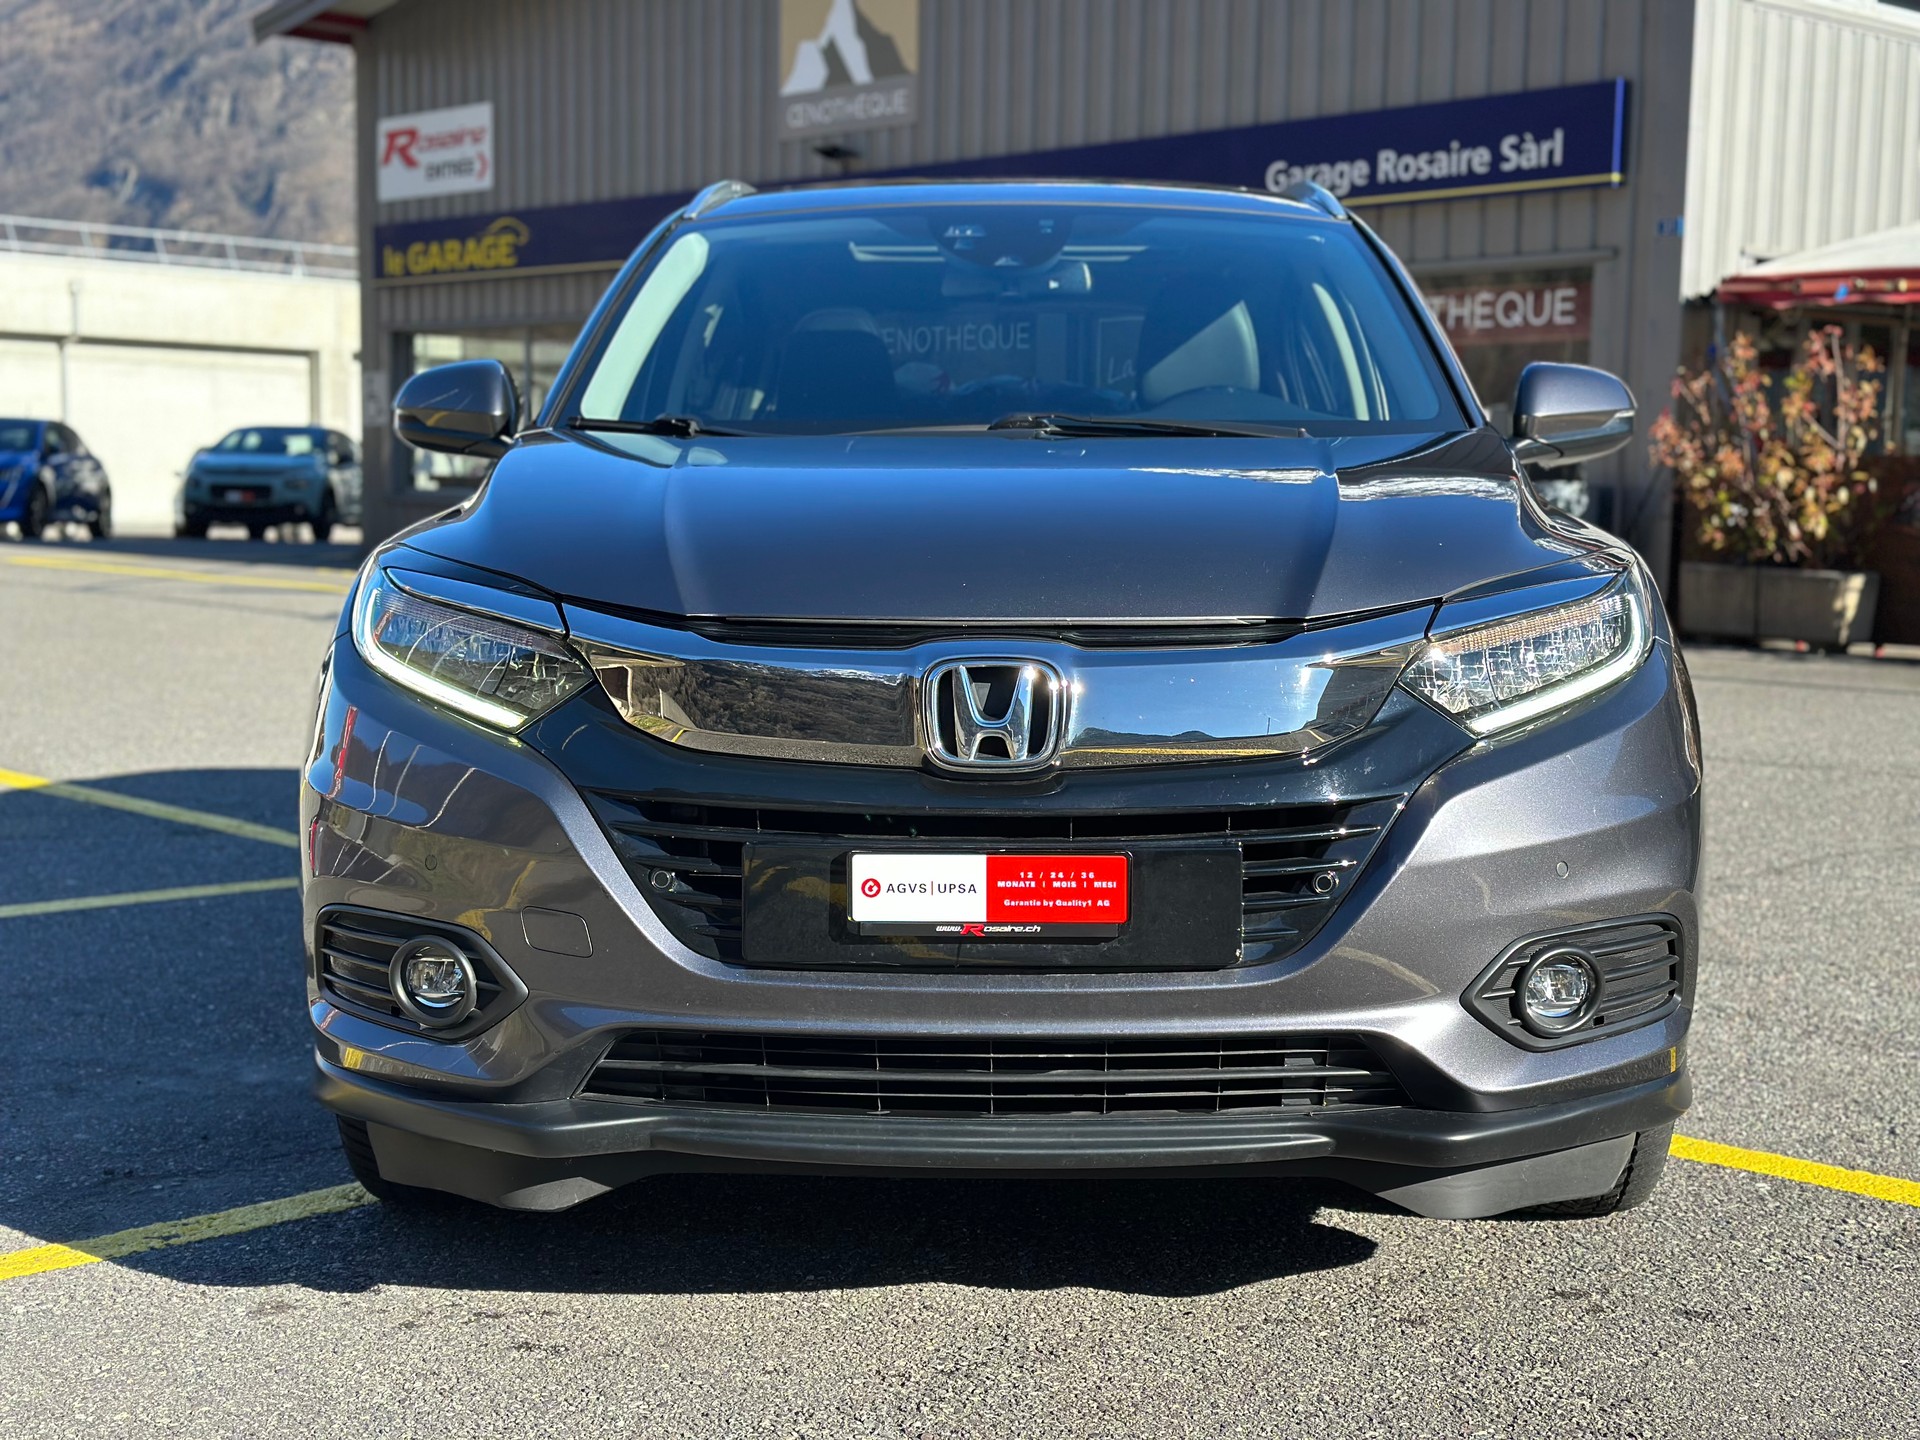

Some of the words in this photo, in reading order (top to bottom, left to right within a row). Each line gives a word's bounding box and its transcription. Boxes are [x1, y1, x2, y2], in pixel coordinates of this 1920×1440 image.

[1264, 159, 1371, 197] Garage
[1376, 140, 1491, 184] Rosaire
[1499, 127, 1565, 173] Sàrl
[407, 232, 518, 275] GARAGE
[1019, 871, 1033, 879] 12
[1050, 871, 1064, 879] 24
[1081, 871, 1095, 879] 36
[886, 883, 927, 895] AGVS
[937, 883, 977, 895] UPSA
[1003, 899, 1041, 907] Garantie
[1043, 899, 1053, 908] by
[1096, 899, 1110, 907] AG
[935, 923, 1041, 937] www.Rosaire.ch
